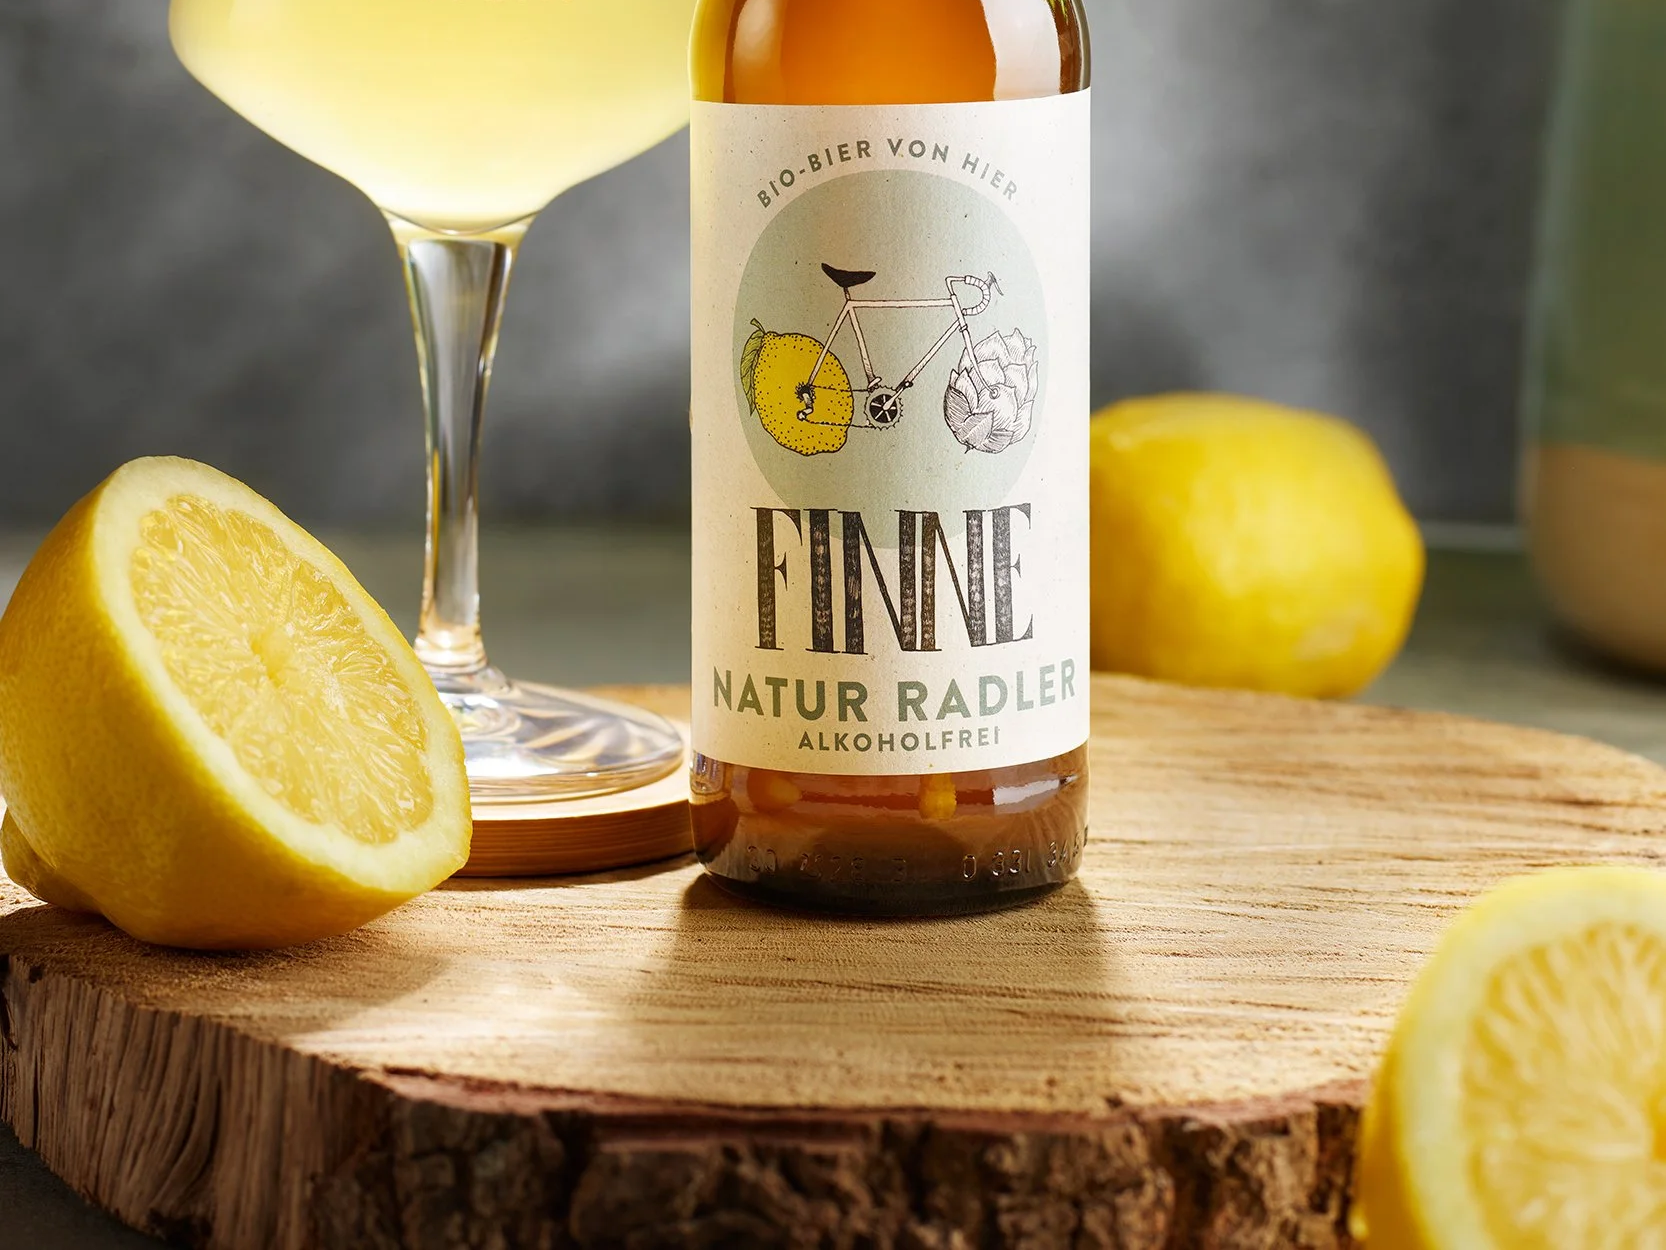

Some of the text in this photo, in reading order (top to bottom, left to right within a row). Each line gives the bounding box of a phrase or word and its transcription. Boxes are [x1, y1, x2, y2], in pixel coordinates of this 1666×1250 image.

[756, 138, 1019, 209] BIO-BIER VON HIER
[749, 502, 1035, 656] FINNE
[712, 658, 1077, 723] NATUR RADLER
[797, 726, 1001, 753] ALKOHOLFREI
